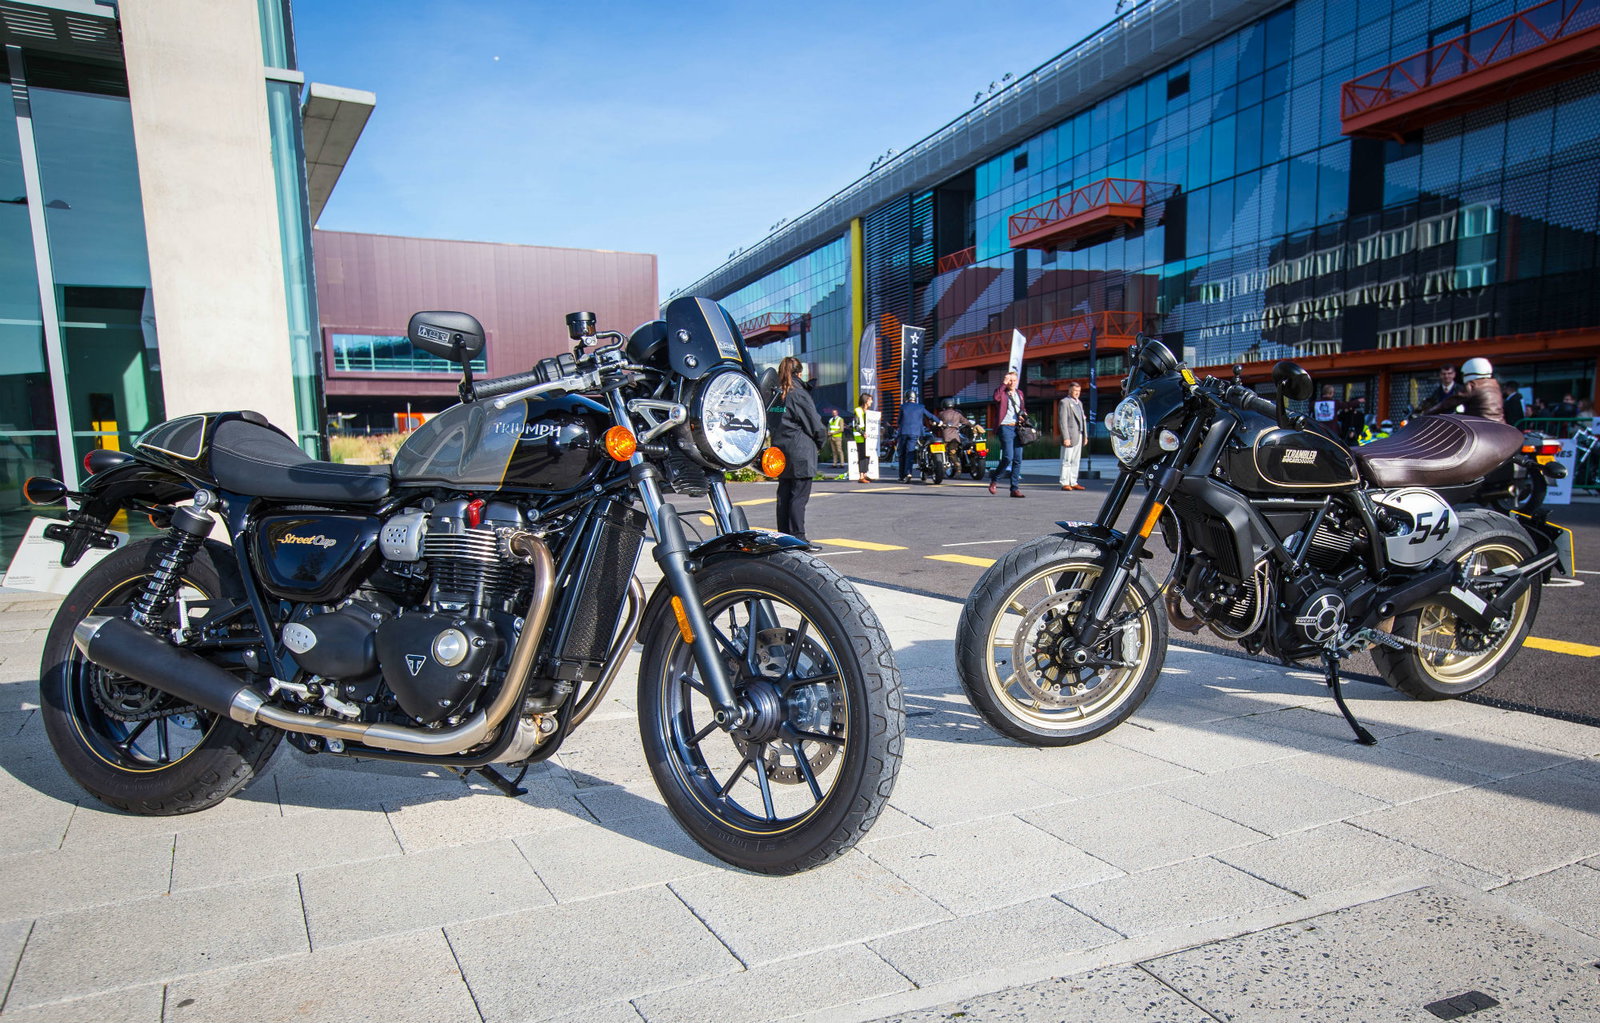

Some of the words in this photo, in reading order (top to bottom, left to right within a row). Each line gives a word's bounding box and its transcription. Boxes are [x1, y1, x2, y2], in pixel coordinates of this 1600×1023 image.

[911, 347, 919, 404] ENITH
[494, 422, 562, 437] TRIUMPH
[1285, 448, 1318, 460] SCRAMBLER
[1408, 509, 1450, 545] 54
